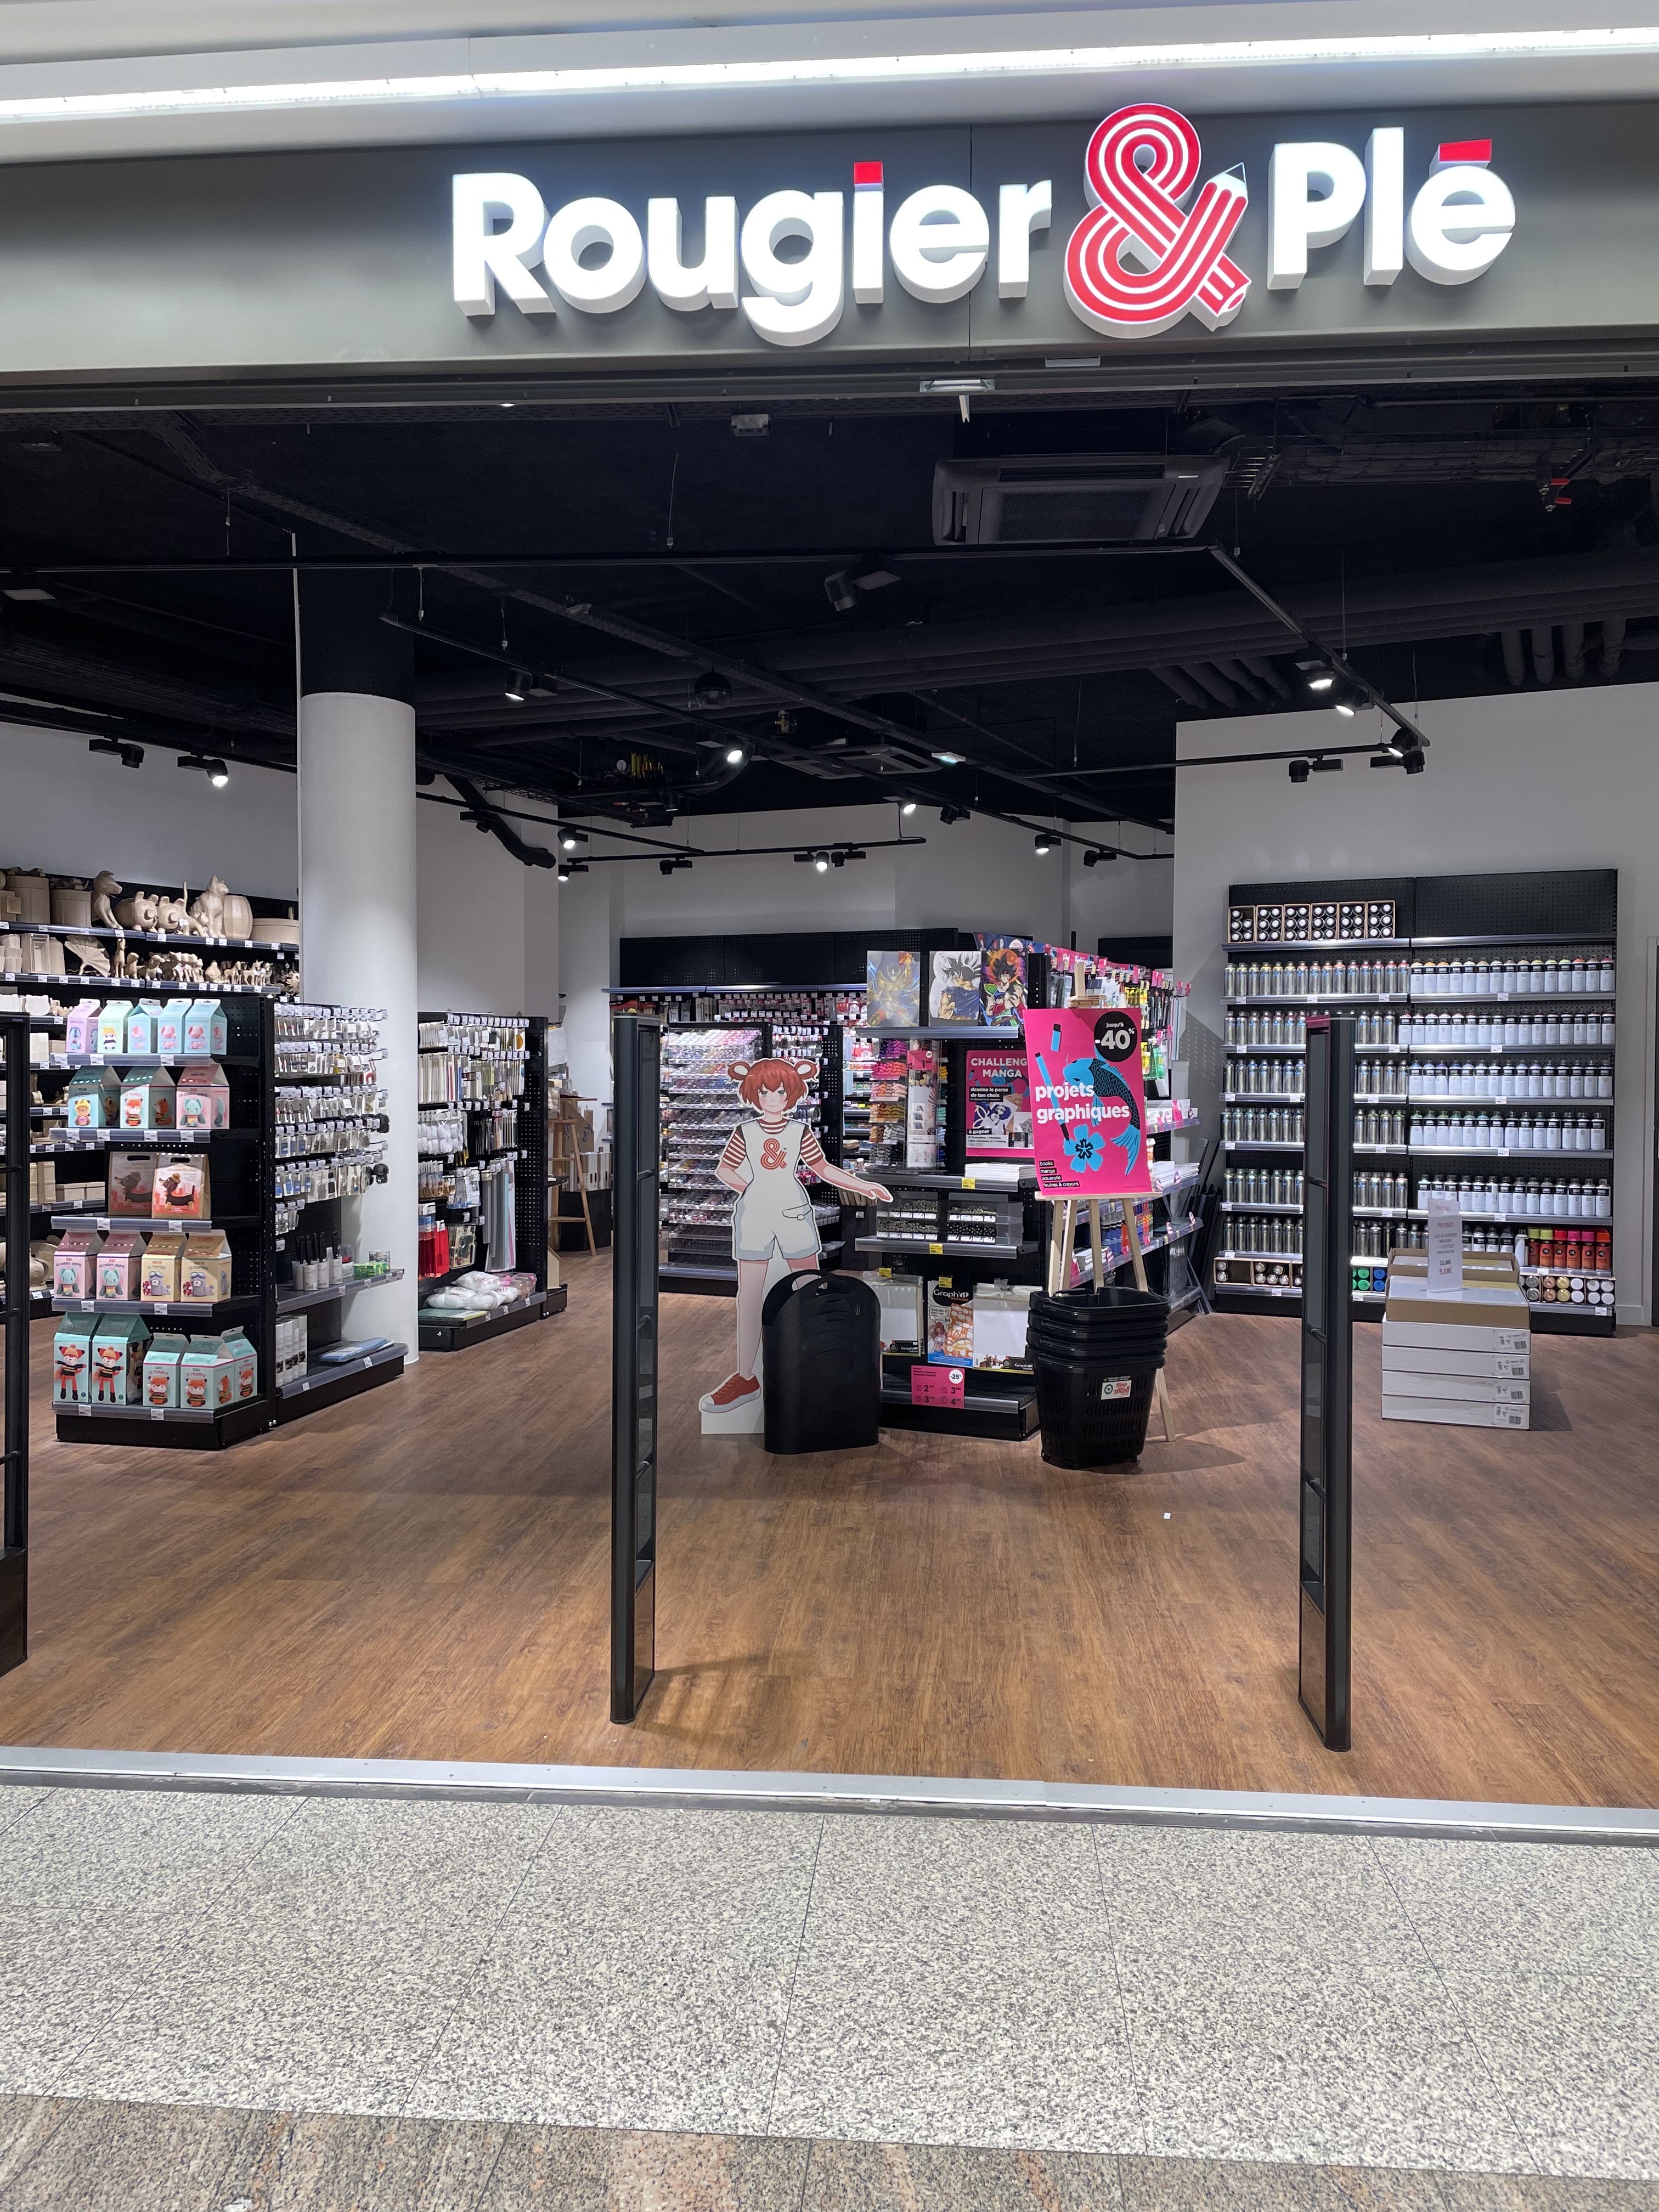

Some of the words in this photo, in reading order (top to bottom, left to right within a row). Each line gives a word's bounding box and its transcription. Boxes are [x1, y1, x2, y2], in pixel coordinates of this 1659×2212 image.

[452, 161, 1052, 347] Rougier
[1064, 103, 1252, 338] &
[1267, 127, 1516, 290] Plé
[970, 1058, 1028, 1066] CHALLENG
[983, 1069, 1023, 1077] MANGA
[1035, 1082, 1094, 1102] projets
[1036, 1103, 1130, 1124] graphiques
[760, 1138, 787, 1170] &
